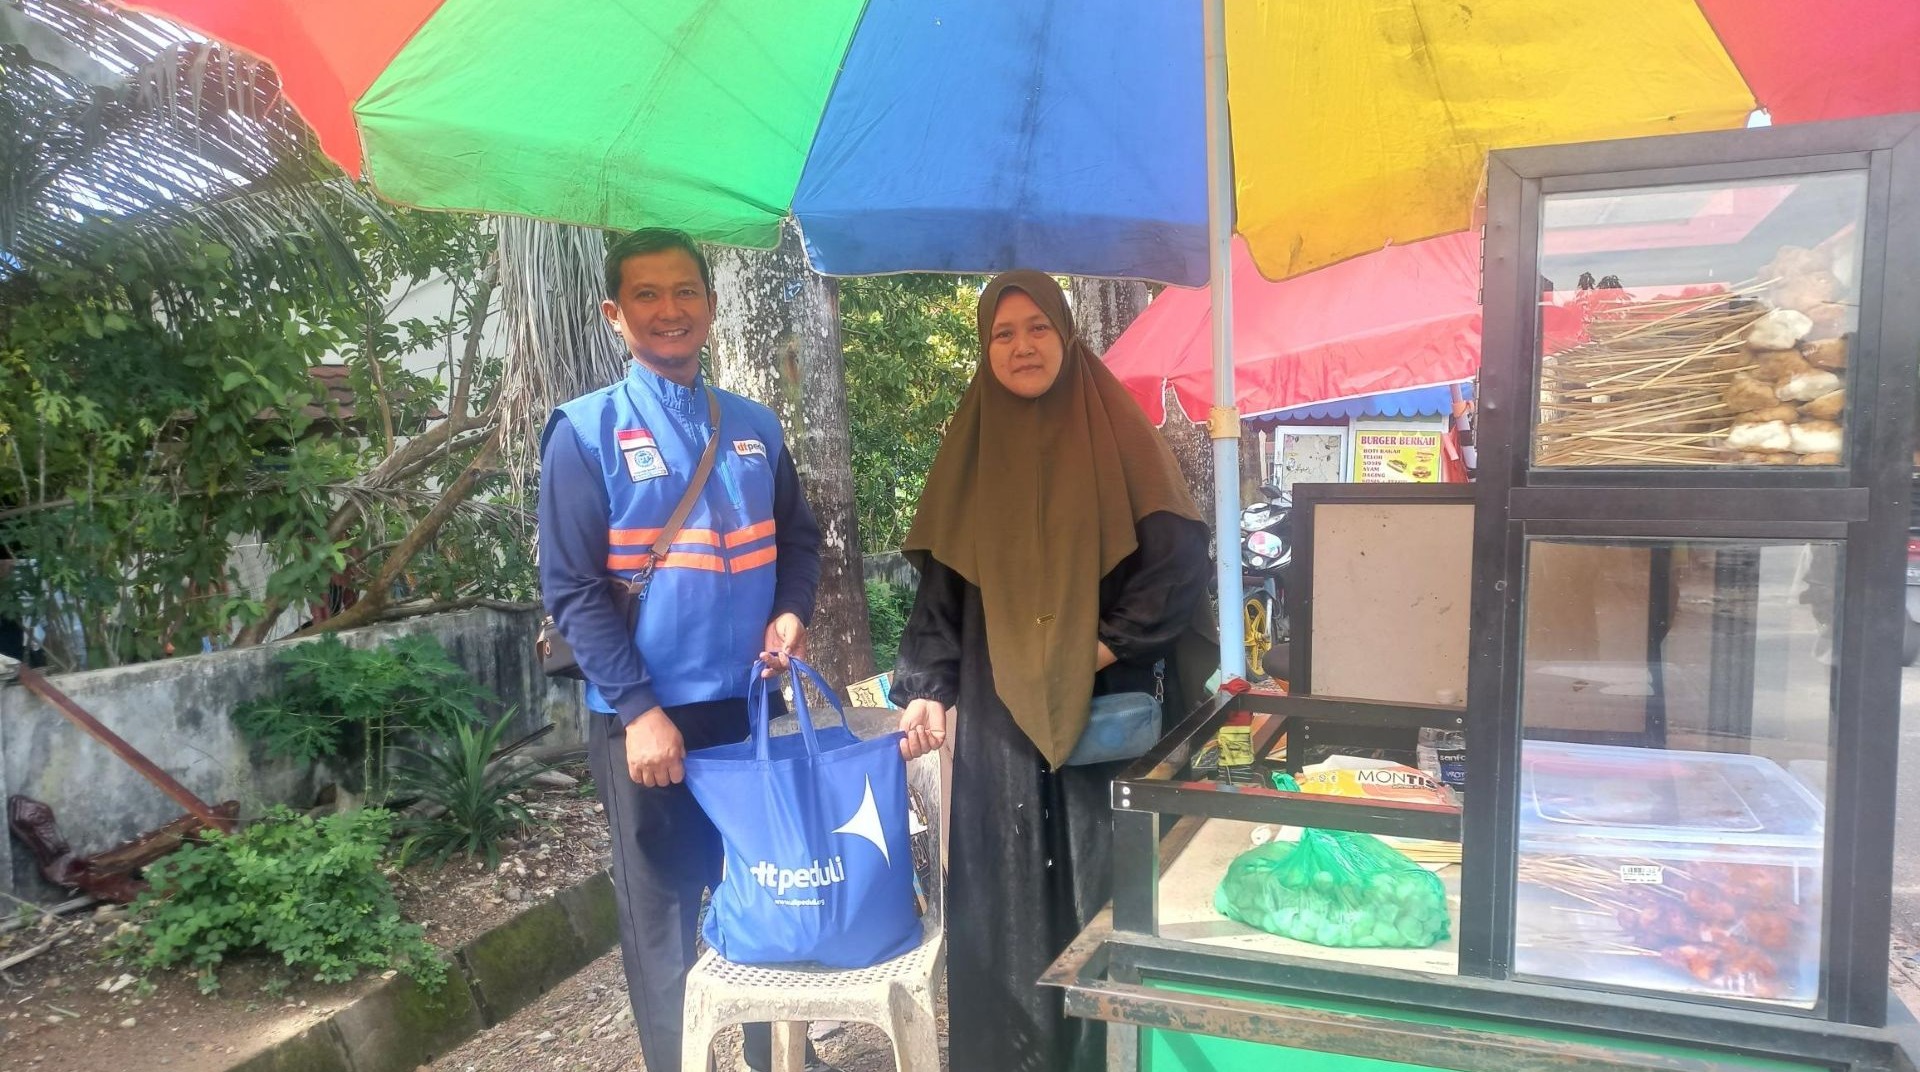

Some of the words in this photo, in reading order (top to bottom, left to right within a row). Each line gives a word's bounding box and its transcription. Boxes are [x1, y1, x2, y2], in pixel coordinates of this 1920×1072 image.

[1361, 436, 1397, 445] BURGER
[1399, 436, 1436, 446] BERKAH
[1440, 754, 1466, 762] sanfo
[750, 855, 845, 896] dtpeduli
